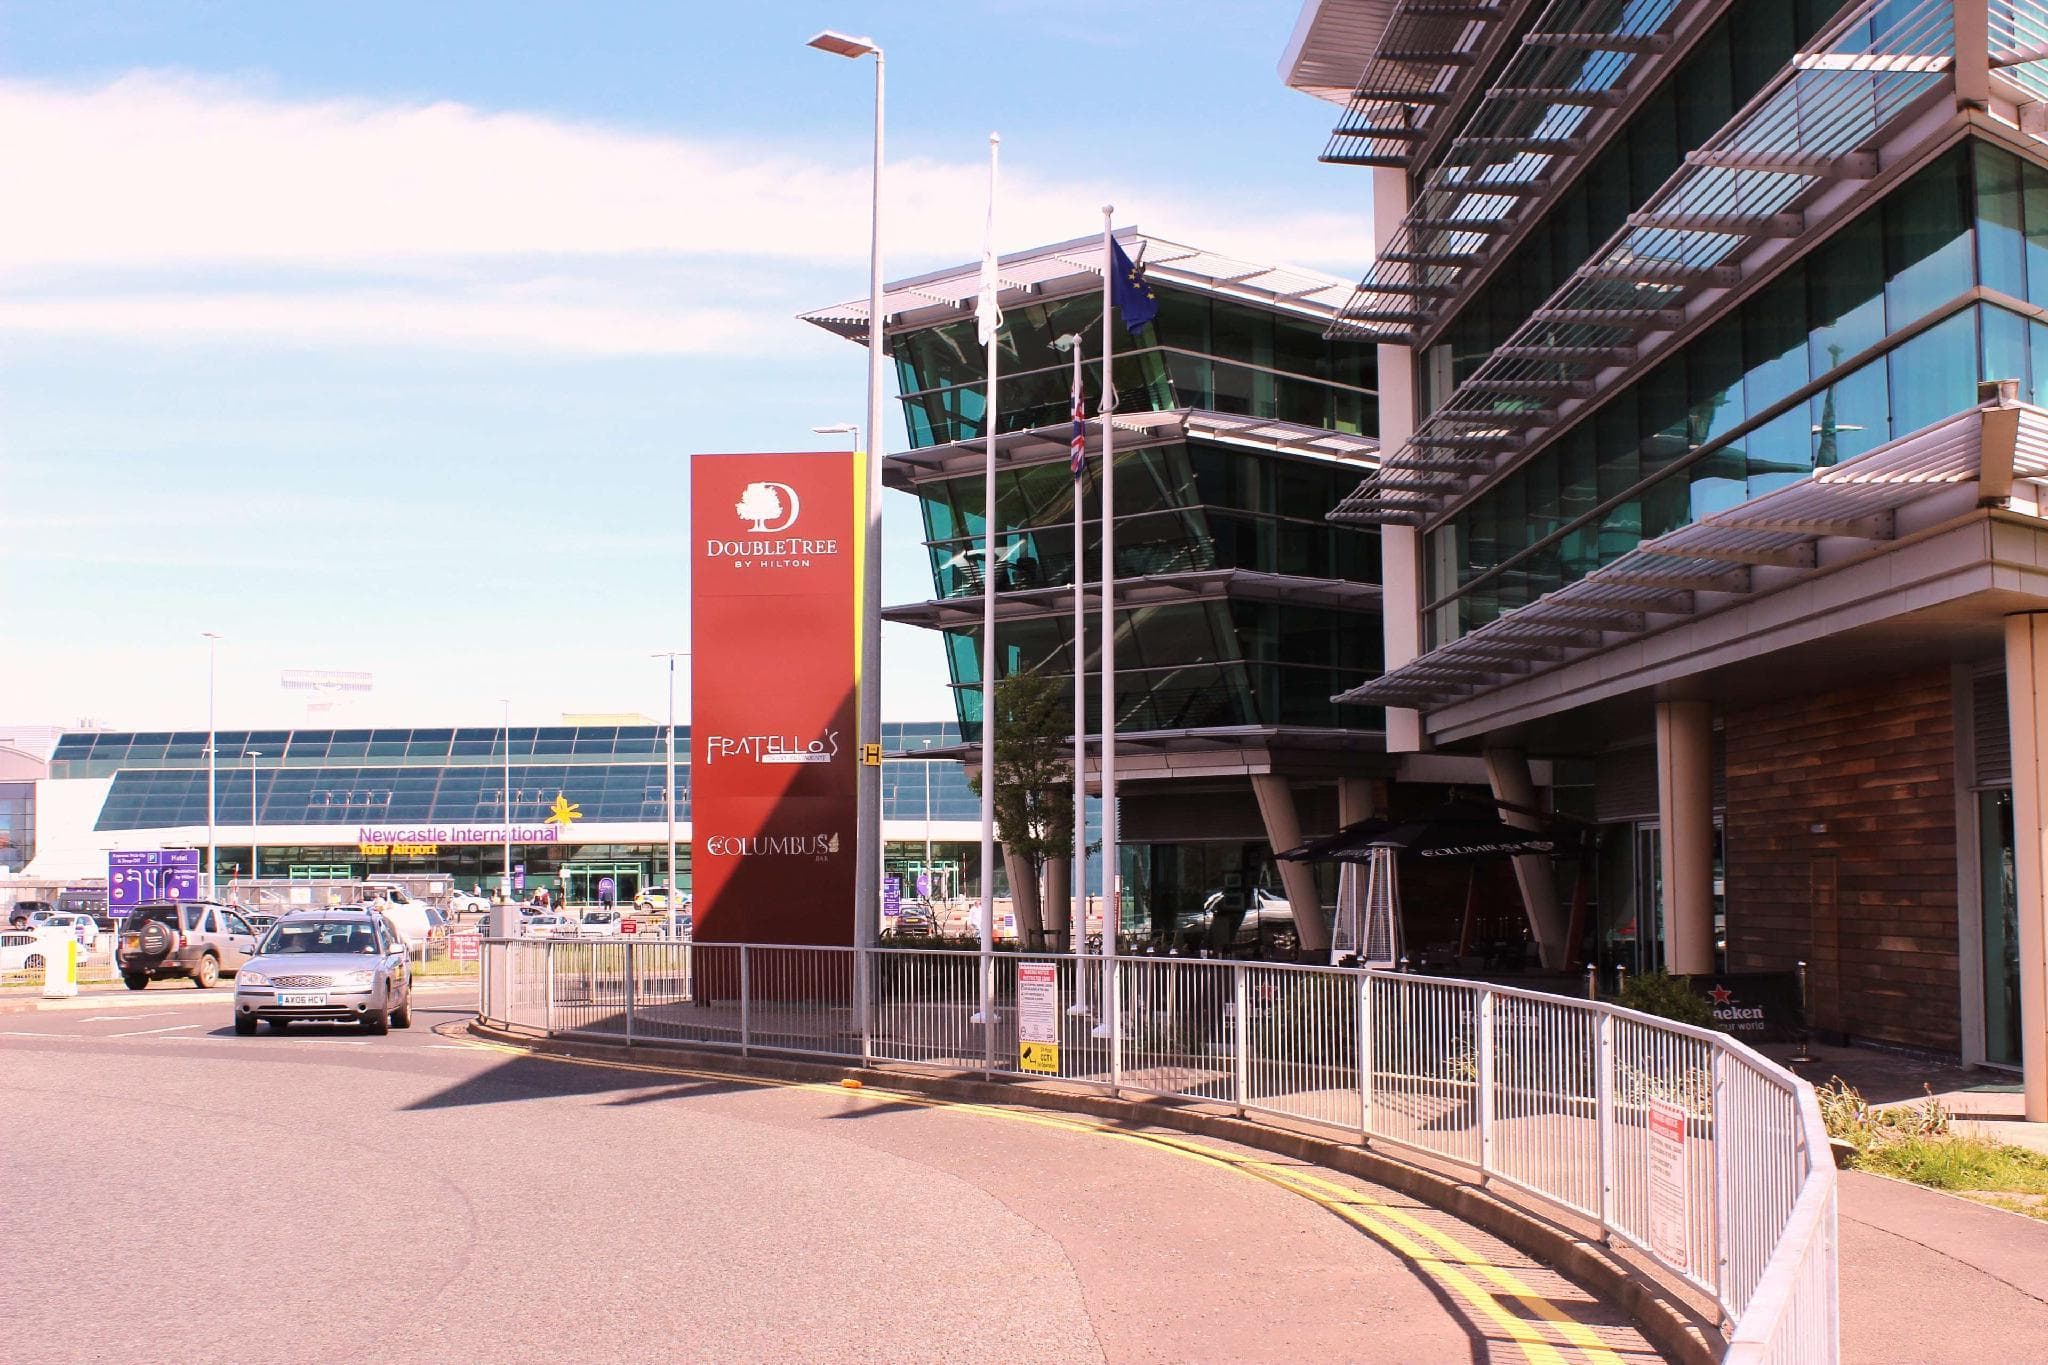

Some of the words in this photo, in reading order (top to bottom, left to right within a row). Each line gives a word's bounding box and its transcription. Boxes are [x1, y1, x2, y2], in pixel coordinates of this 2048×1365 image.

[760, 559, 810, 567] HILTON
[707, 728, 838, 765] FRATELLO'S
[866, 745, 880, 763] H
[359, 827, 447, 842] Newcastle
[452, 825, 558, 842] International
[359, 843, 388, 855] Your
[391, 844, 437, 857] Airport
[707, 833, 828, 856] COLUMBUS
[1713, 1006, 1764, 1020] neken
[1738, 1021, 1765, 1031] world
